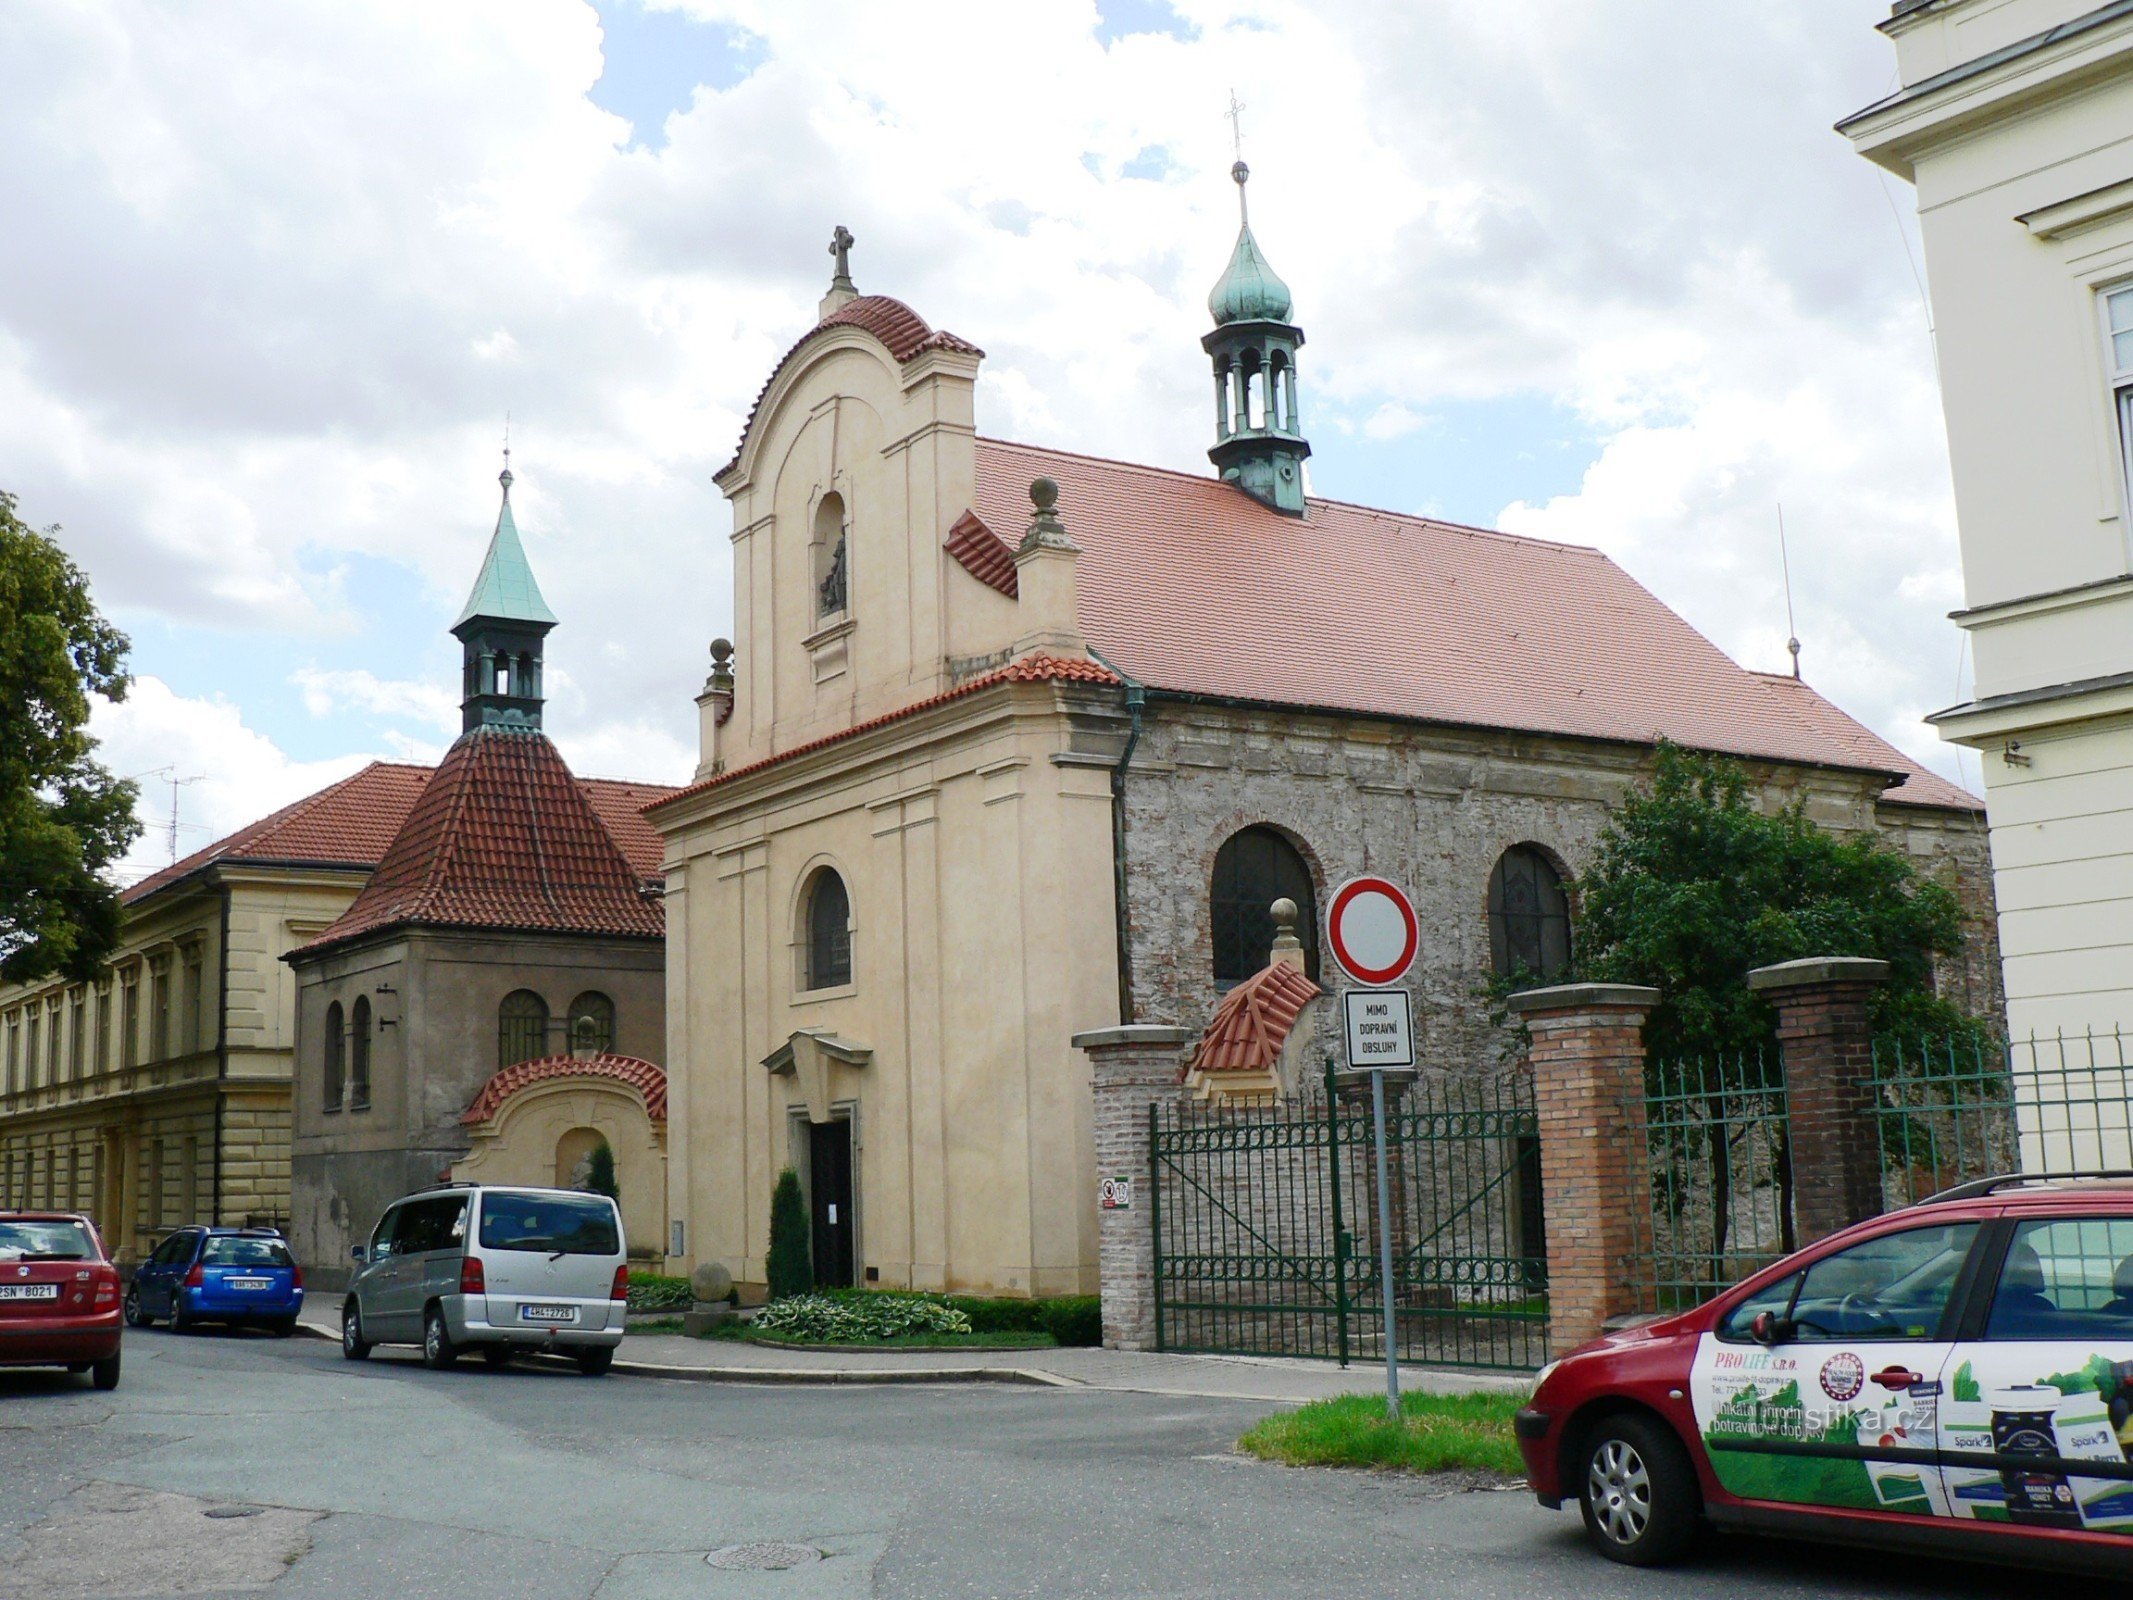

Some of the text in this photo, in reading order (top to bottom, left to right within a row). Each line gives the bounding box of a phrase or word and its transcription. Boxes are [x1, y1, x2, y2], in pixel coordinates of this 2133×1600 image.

[1366, 1004, 1388, 1016] MIMO
[1360, 1020, 1398, 1035] DOPRAVNÍ
[1362, 1041, 1398, 1054] OBSLUHY
[25, 1286, 52, 1297] 8021
[1714, 1352, 1771, 1369] PROLIFE
